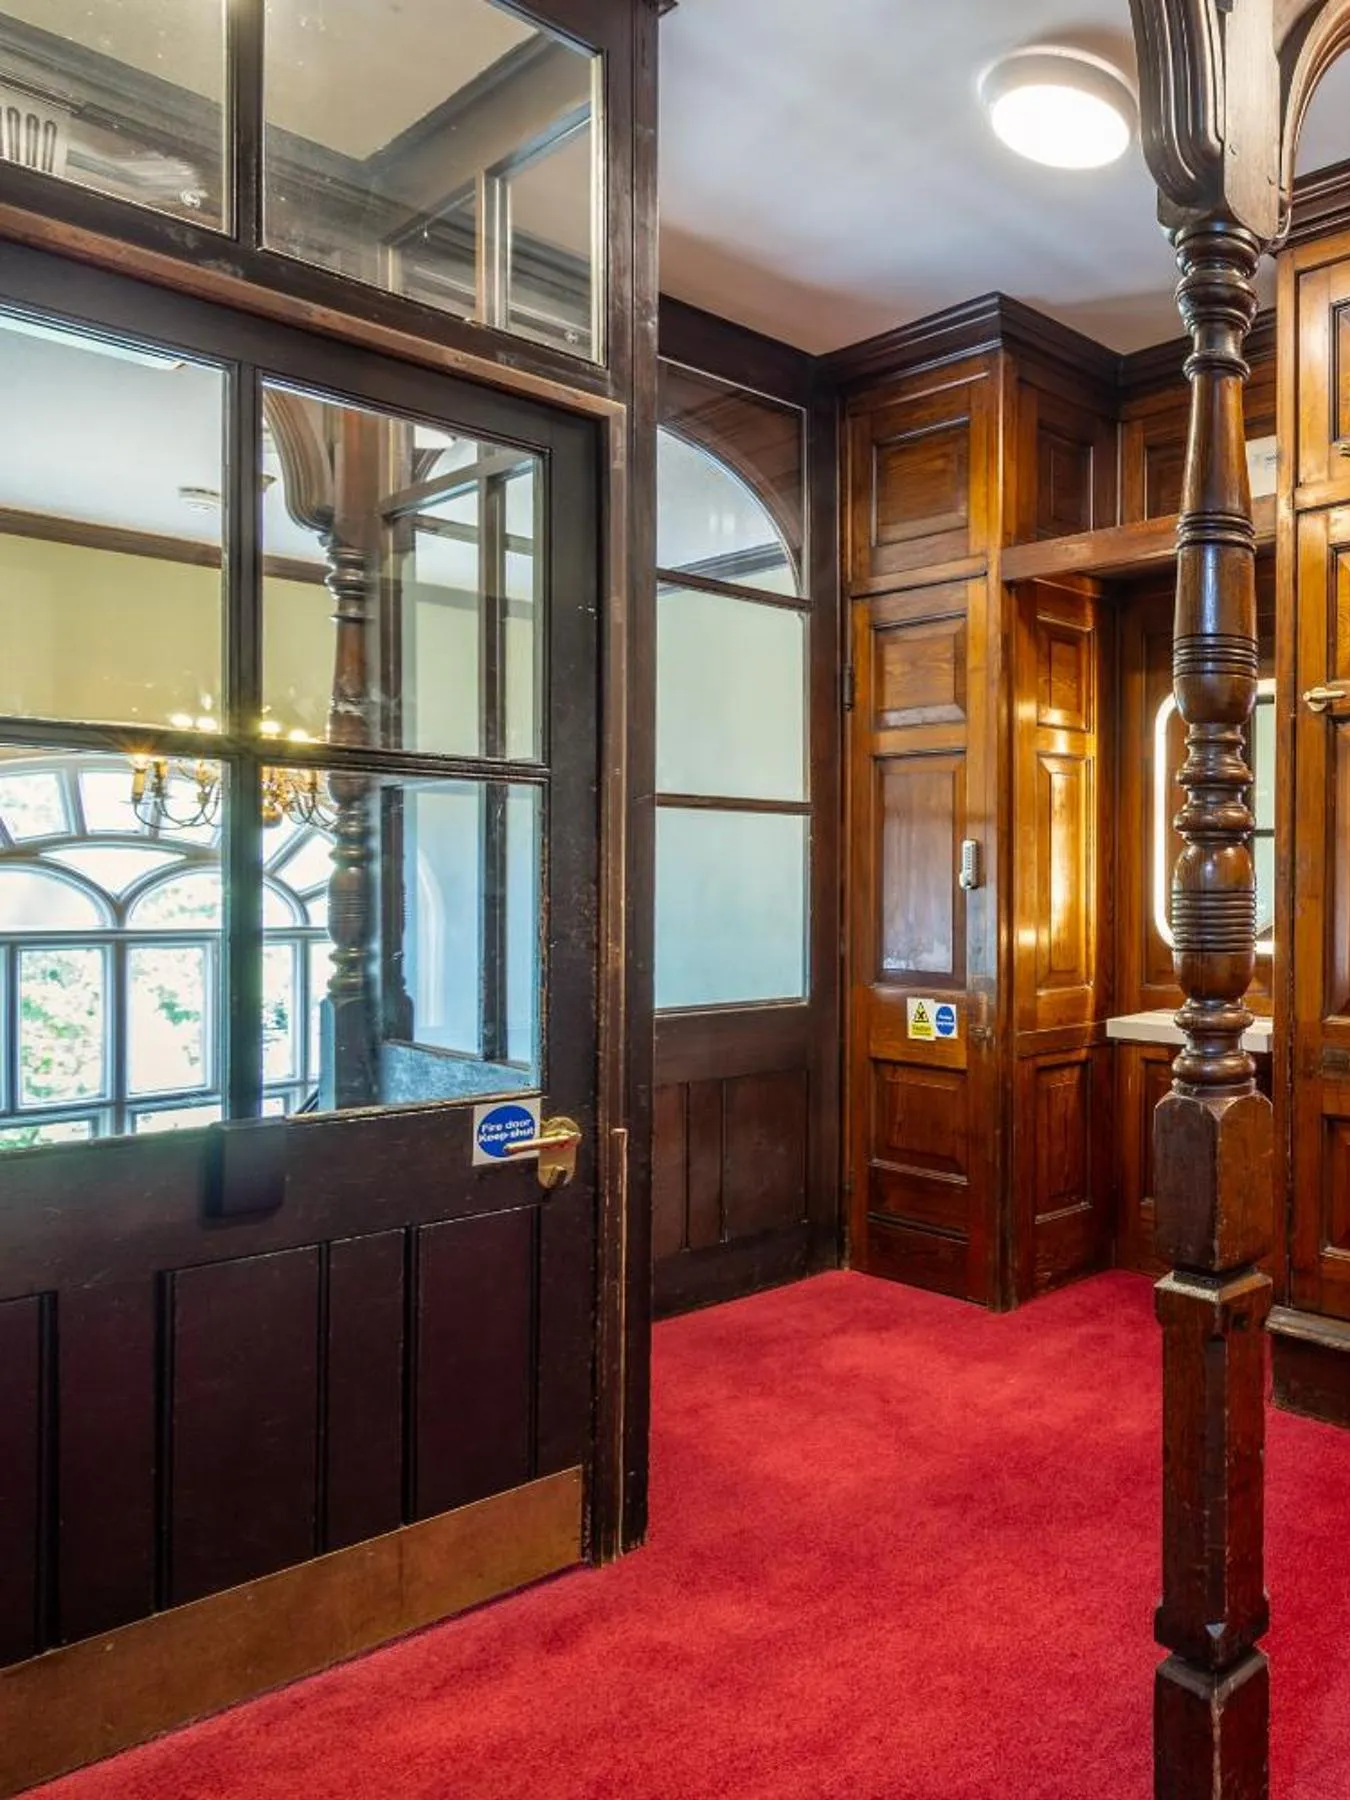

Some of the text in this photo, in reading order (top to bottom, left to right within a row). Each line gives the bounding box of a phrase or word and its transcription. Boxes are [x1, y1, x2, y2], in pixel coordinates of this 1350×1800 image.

[481, 1119, 532, 1133] Fire door
[478, 1126, 535, 1143] Keep shut
